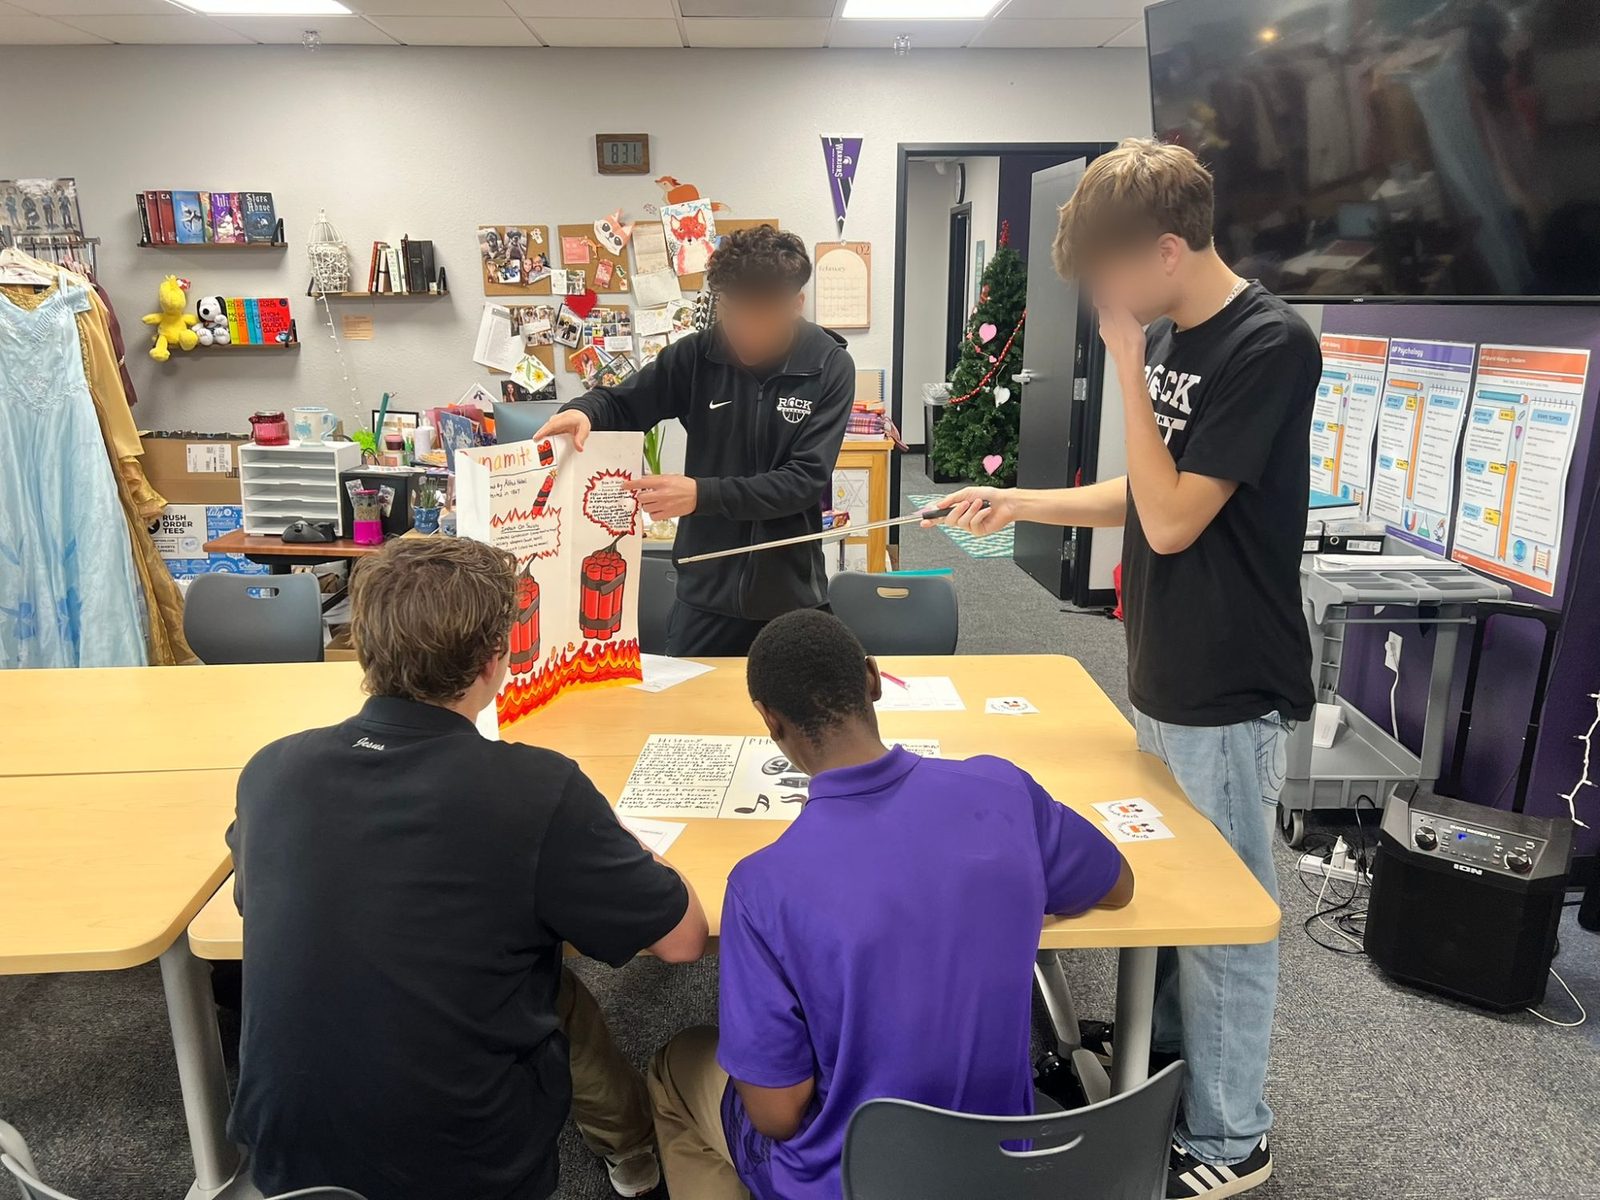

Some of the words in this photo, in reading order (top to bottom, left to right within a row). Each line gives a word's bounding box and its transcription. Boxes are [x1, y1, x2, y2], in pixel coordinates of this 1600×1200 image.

[835, 143, 844, 178] WARRIORS
[1398, 347, 1424, 358] Psychology
[478, 446, 533, 472] namite
[1453, 863, 1483, 875] ION
